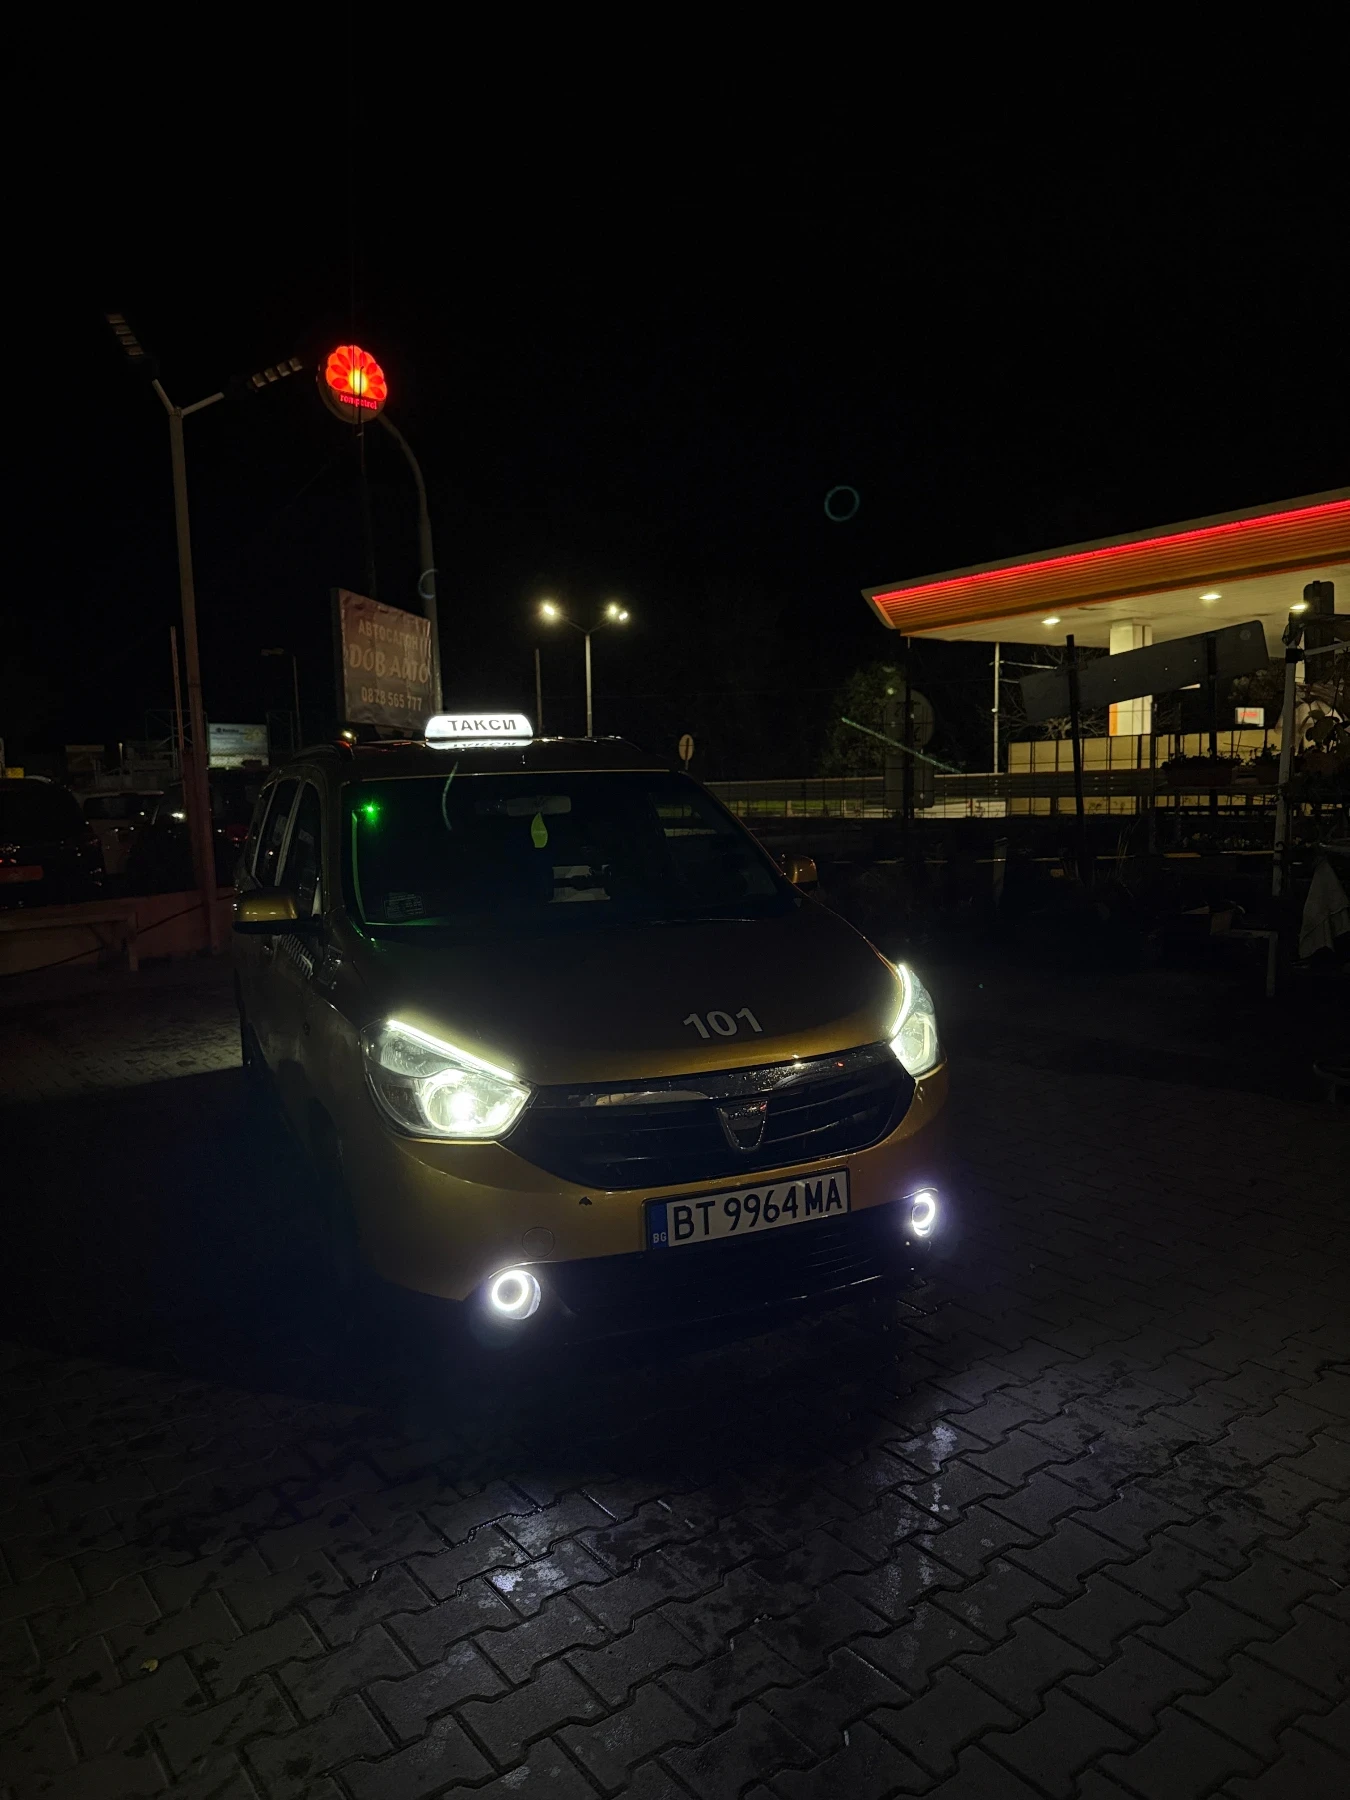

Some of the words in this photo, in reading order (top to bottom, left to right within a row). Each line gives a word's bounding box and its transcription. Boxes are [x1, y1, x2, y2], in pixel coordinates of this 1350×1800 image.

[358, 619, 418, 647] АВТОСАЛОН
[349, 643, 386, 678] DOB
[388, 691, 405, 709] 565
[407, 695, 422, 711] 777
[447, 719, 517, 732] ТАКСИ
[682, 1007, 763, 1039] 101
[673, 1200, 716, 1241] BT
[723, 1186, 798, 1231] 9964
[804, 1178, 842, 1216] MA
[652, 1231, 668, 1244] BG
